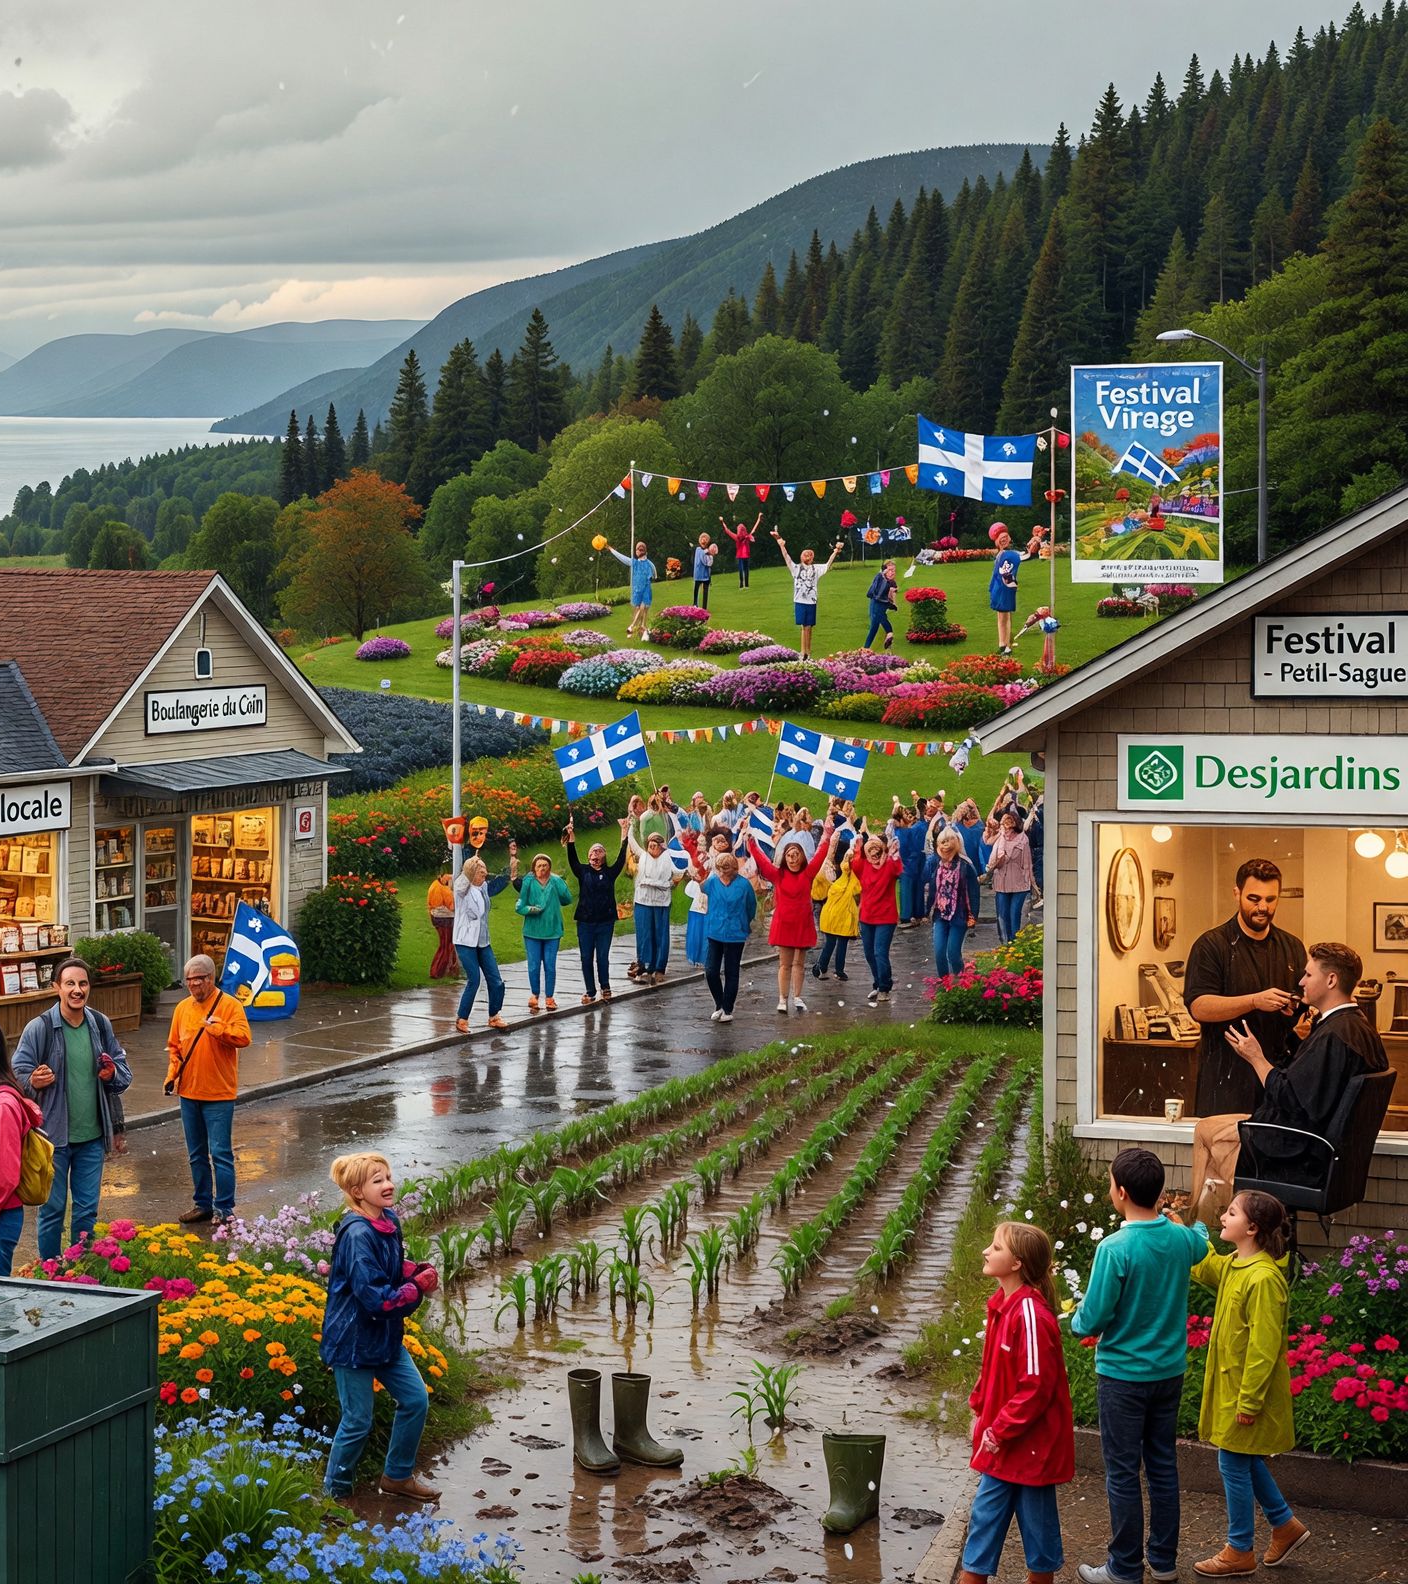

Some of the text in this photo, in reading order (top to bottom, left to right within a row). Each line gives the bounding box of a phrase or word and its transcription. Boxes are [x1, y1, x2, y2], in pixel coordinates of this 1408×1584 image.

[1096, 378, 1200, 405] Festival
[1099, 405, 1194, 436] Virage
[1266, 622, 1396, 654] Festival
[223, 696, 237, 716] du
[239, 694, 263, 715] Coin
[1195, 755, 1401, 799] Desjardins
[0, 790, 63, 823] locale
